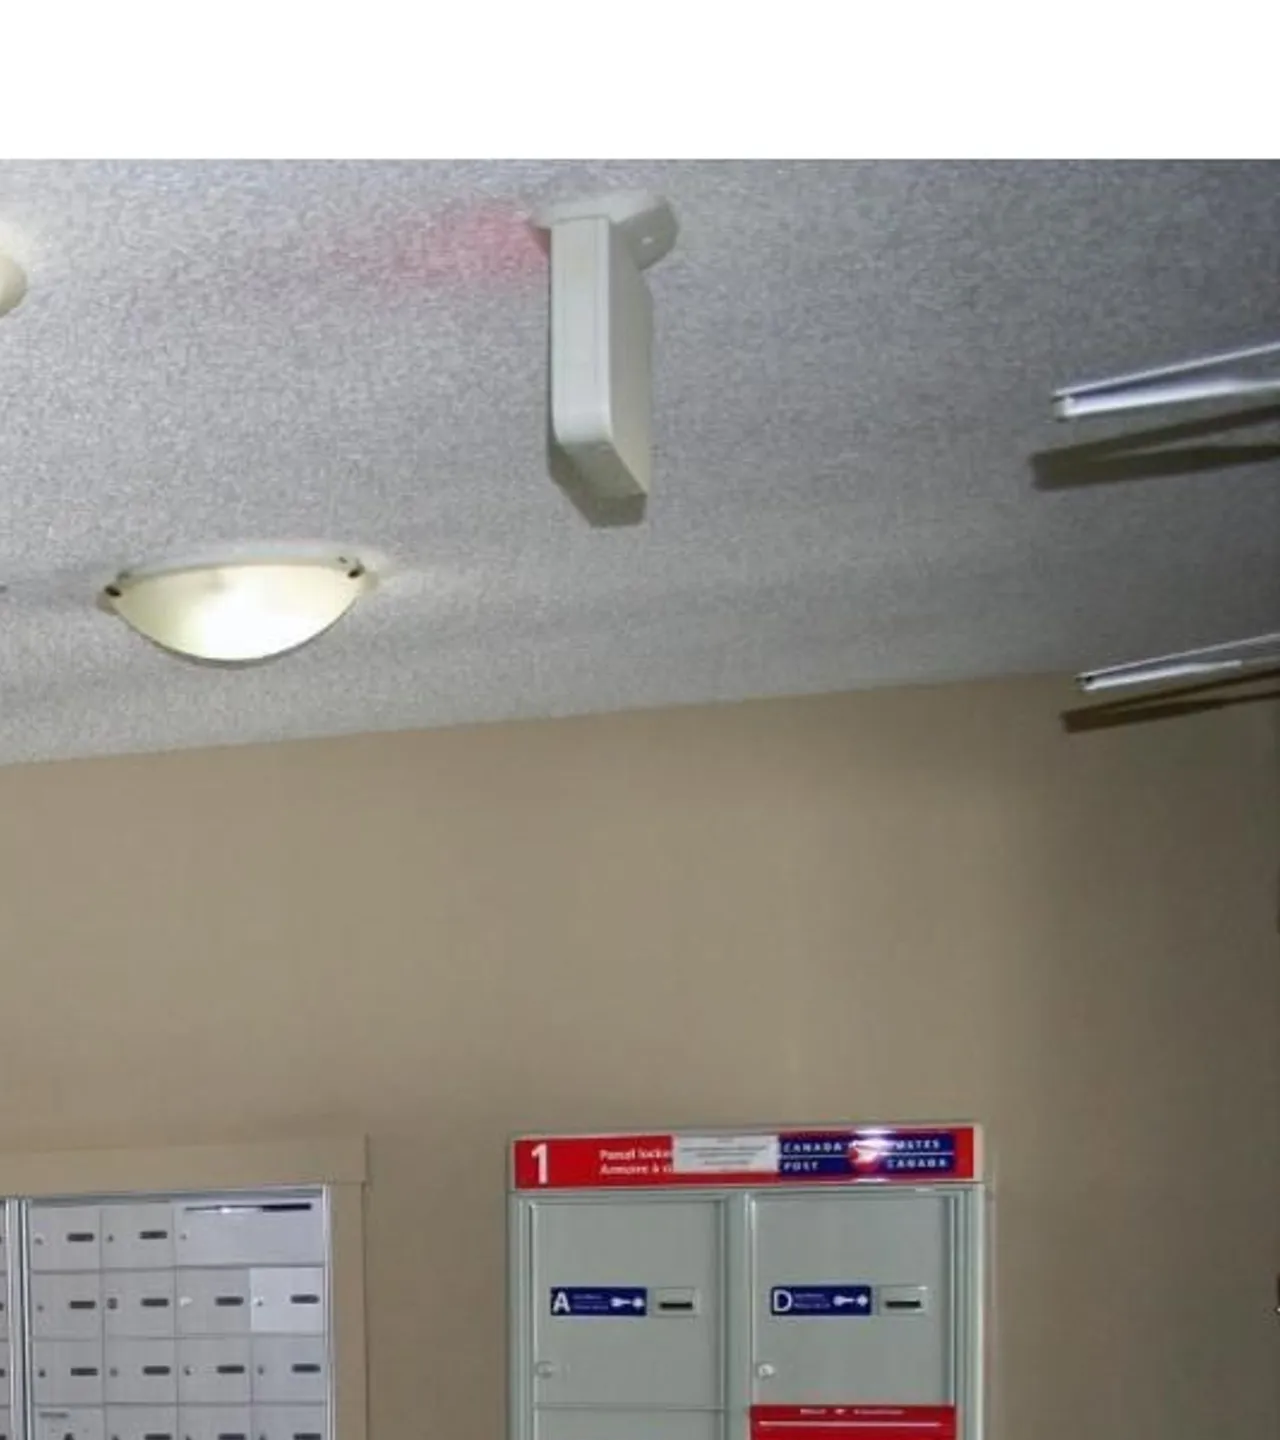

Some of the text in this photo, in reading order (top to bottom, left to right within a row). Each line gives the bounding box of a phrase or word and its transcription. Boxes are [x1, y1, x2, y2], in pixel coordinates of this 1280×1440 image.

[783, 1142, 842, 1153] CANADA
[531, 1143, 548, 1184] 1
[783, 1161, 820, 1172] POST
[887, 1157, 948, 1169] CANADA
[552, 1291, 571, 1313] A
[773, 1289, 792, 1312] D
